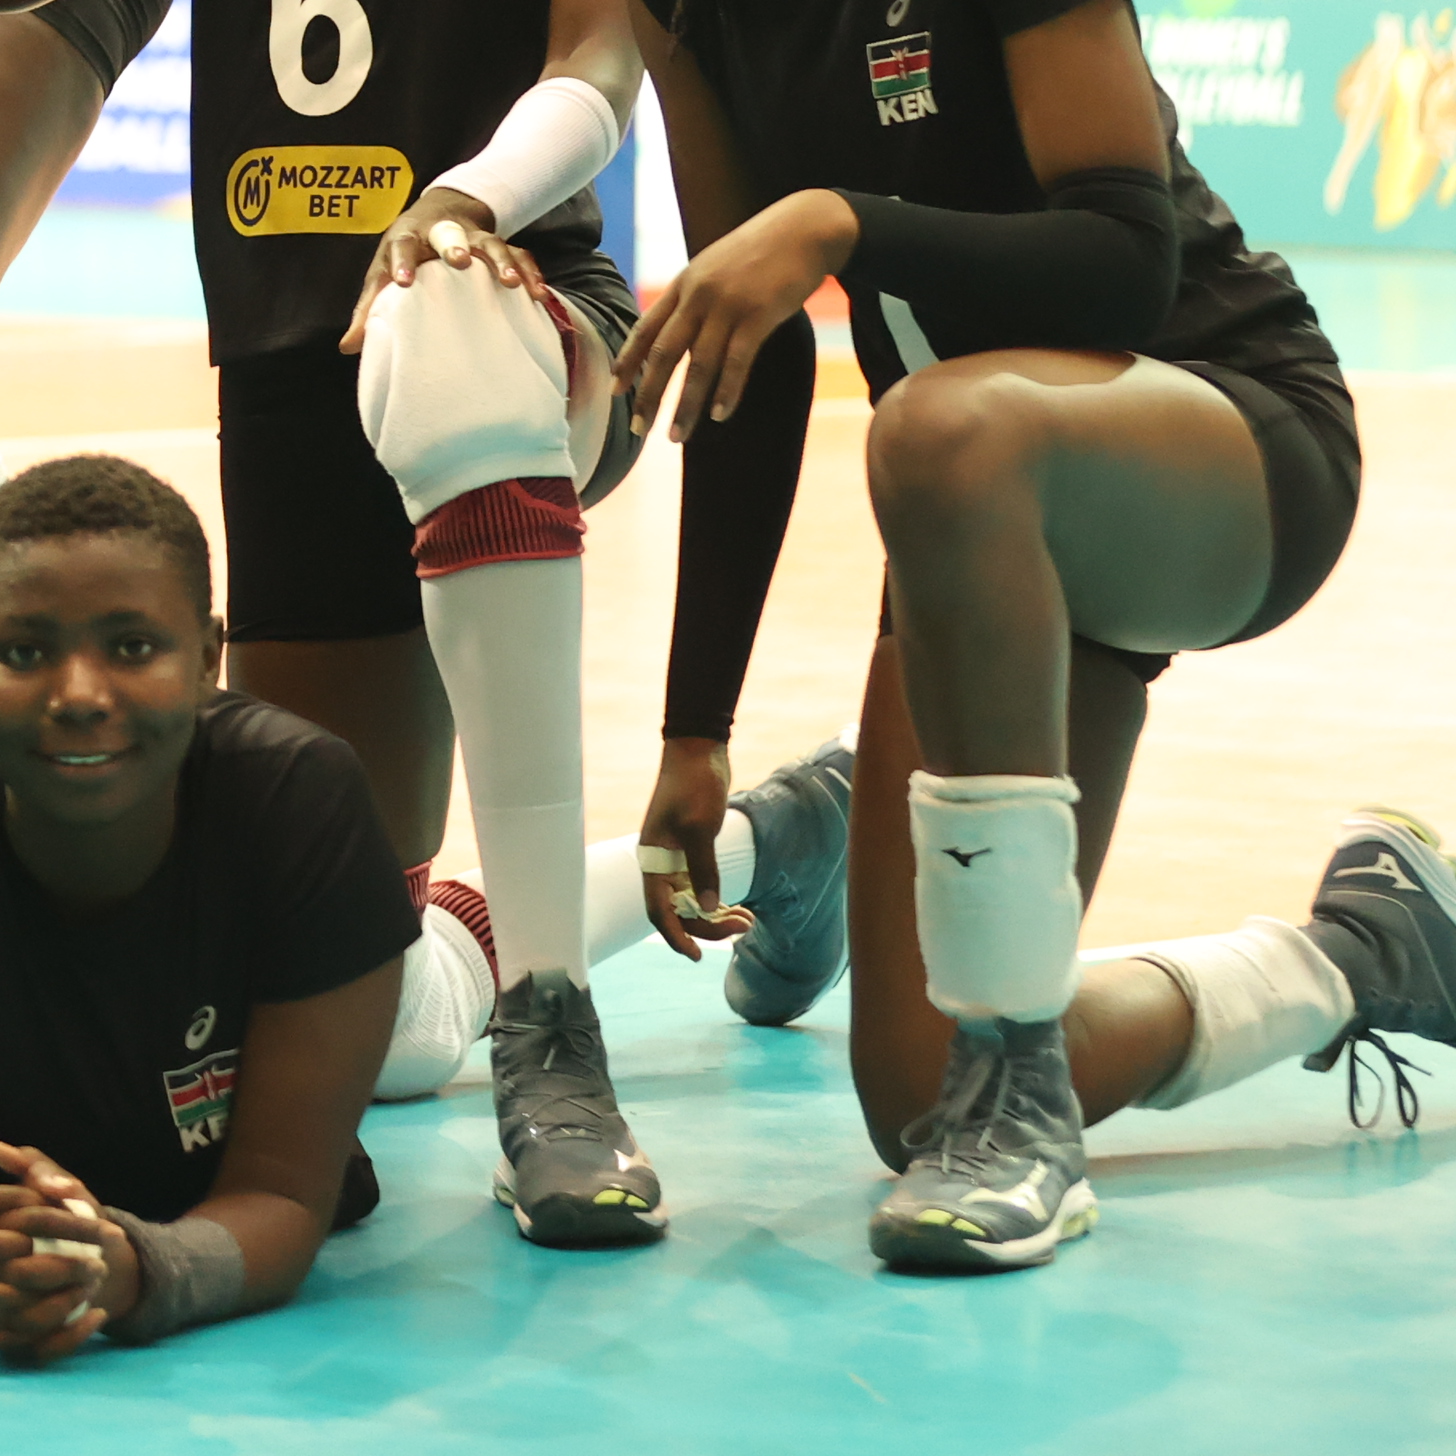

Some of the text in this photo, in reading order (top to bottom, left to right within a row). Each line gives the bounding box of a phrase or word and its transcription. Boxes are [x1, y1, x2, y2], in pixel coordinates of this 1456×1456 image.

[877, 89, 938, 126] KEN
[277, 165, 402, 189] MOZZART
[309, 195, 360, 218] BET
